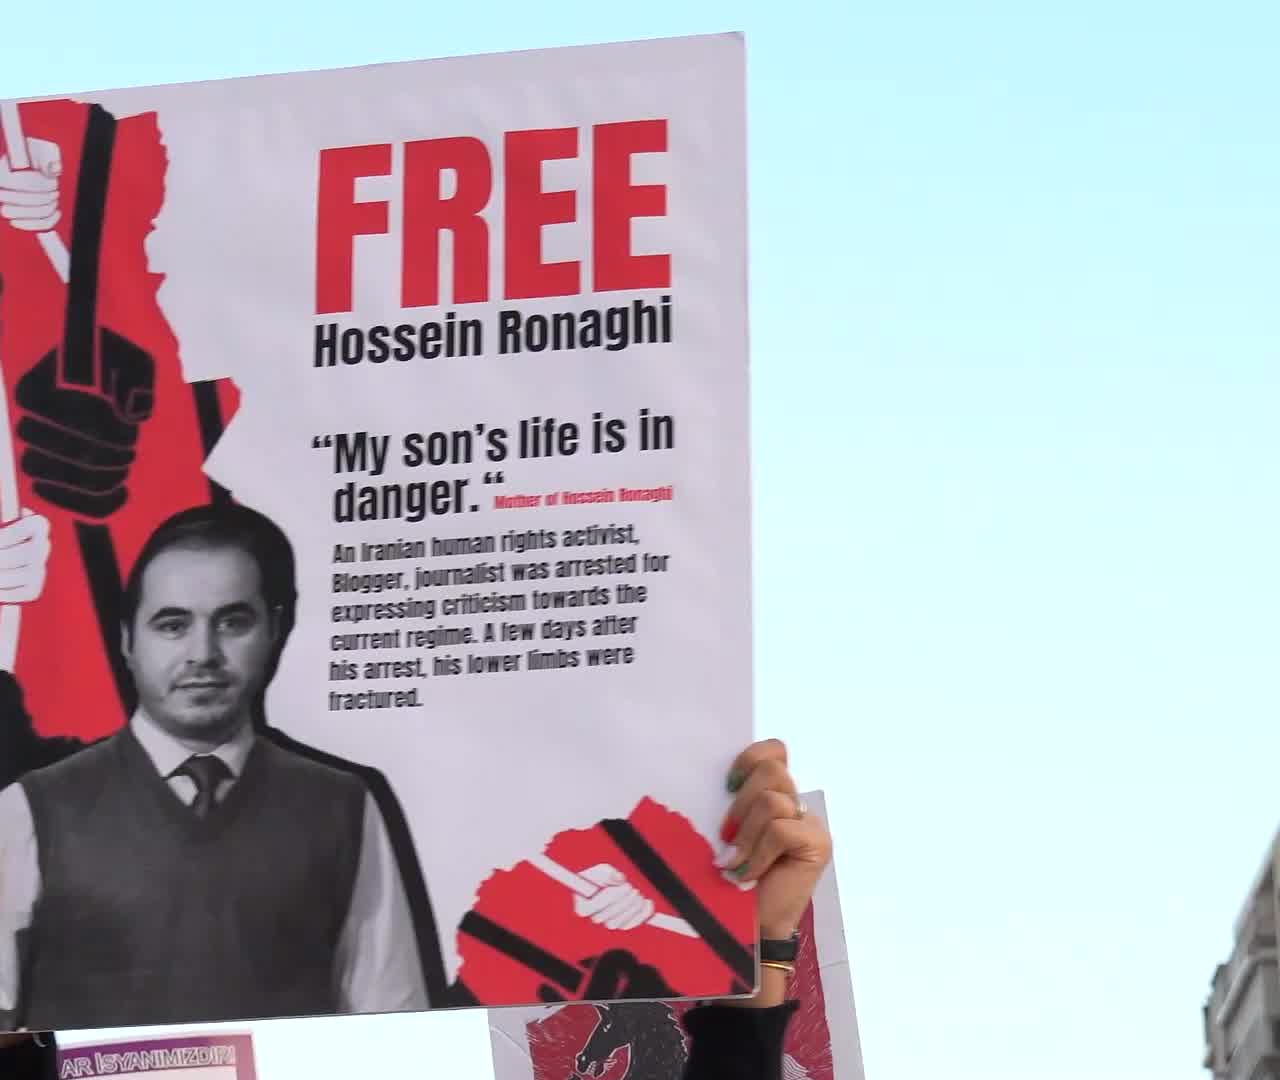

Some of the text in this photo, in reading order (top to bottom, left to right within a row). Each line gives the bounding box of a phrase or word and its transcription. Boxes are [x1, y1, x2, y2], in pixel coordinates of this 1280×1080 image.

[315, 119, 672, 314] FREE
[313, 295, 672, 367] Hossein Ronaghi
[519, 416, 579, 458] life
[592, 412, 626, 454] is
[640, 408, 673, 451] in
[333, 543, 355, 563] An
[360, 538, 425, 562] Iranian
[431, 535, 495, 557] human
[501, 529, 556, 553] rights
[414, 562, 504, 590] journalist
[512, 562, 549, 581] was
[555, 554, 637, 577] arrested
[643, 553, 670, 573] for
[332, 584, 648, 623] expressing criticism towards the
[331, 629, 401, 651] current
[483, 622, 495, 643] A
[501, 622, 536, 642] few
[541, 619, 586, 641] days
[592, 615, 638, 636] after
[328, 660, 358, 681] his
[432, 654, 462, 676] his
[467, 653, 521, 674] lower
[527, 649, 580, 671] limbs
[587, 647, 635, 667] were
